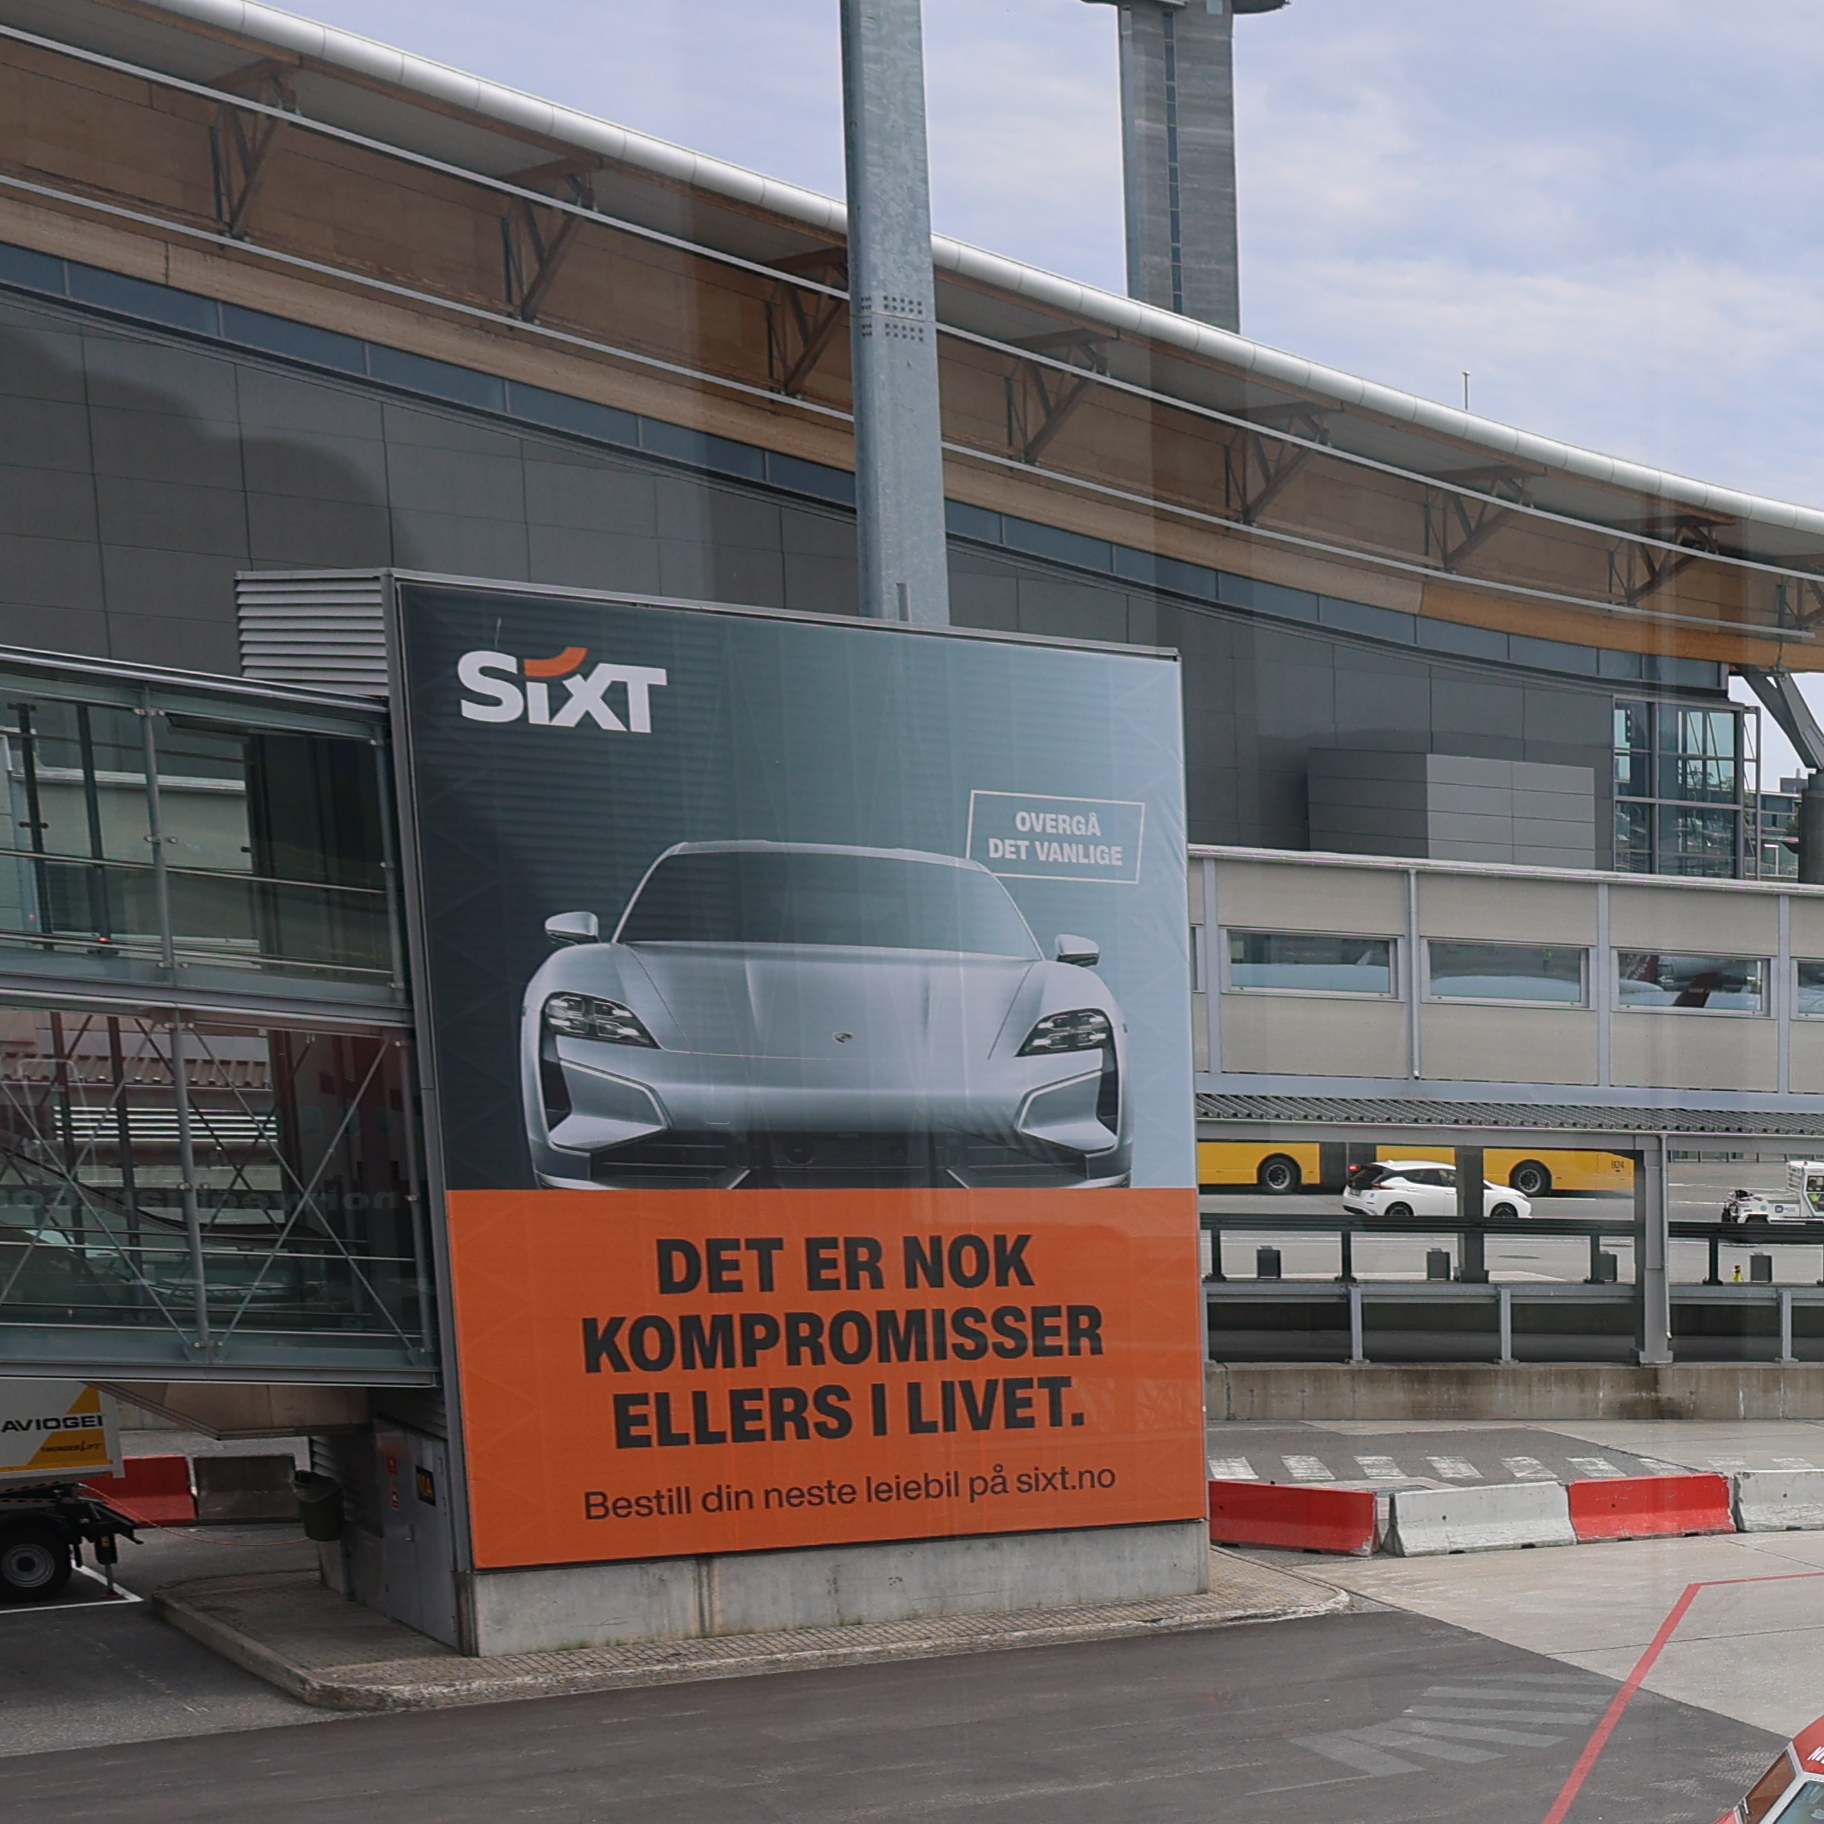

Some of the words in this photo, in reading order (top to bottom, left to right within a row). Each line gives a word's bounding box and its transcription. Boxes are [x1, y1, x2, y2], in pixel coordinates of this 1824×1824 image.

[988, 838, 1030, 860] DET
[1034, 841, 1123, 866] VANLIGE
[1015, 811, 1101, 836] OVERGÅ
[656, 1236, 785, 1295] DET
[805, 1236, 885, 1292] ER
[902, 1233, 1036, 1290] NOK
[582, 1303, 1104, 1374] KOMPROMISSER
[613, 1383, 853, 1450] ELLERS
[871, 1382, 888, 1438] I
[906, 1375, 1085, 1436] LIVET.
[584, 1485, 692, 1521] Bestill
[701, 1480, 754, 1513] din
[763, 1479, 858, 1511] neste
[865, 1470, 960, 1504] leiebil
[968, 1464, 1010, 1505] på
[1016, 1465, 1116, 1495] sixt.no
